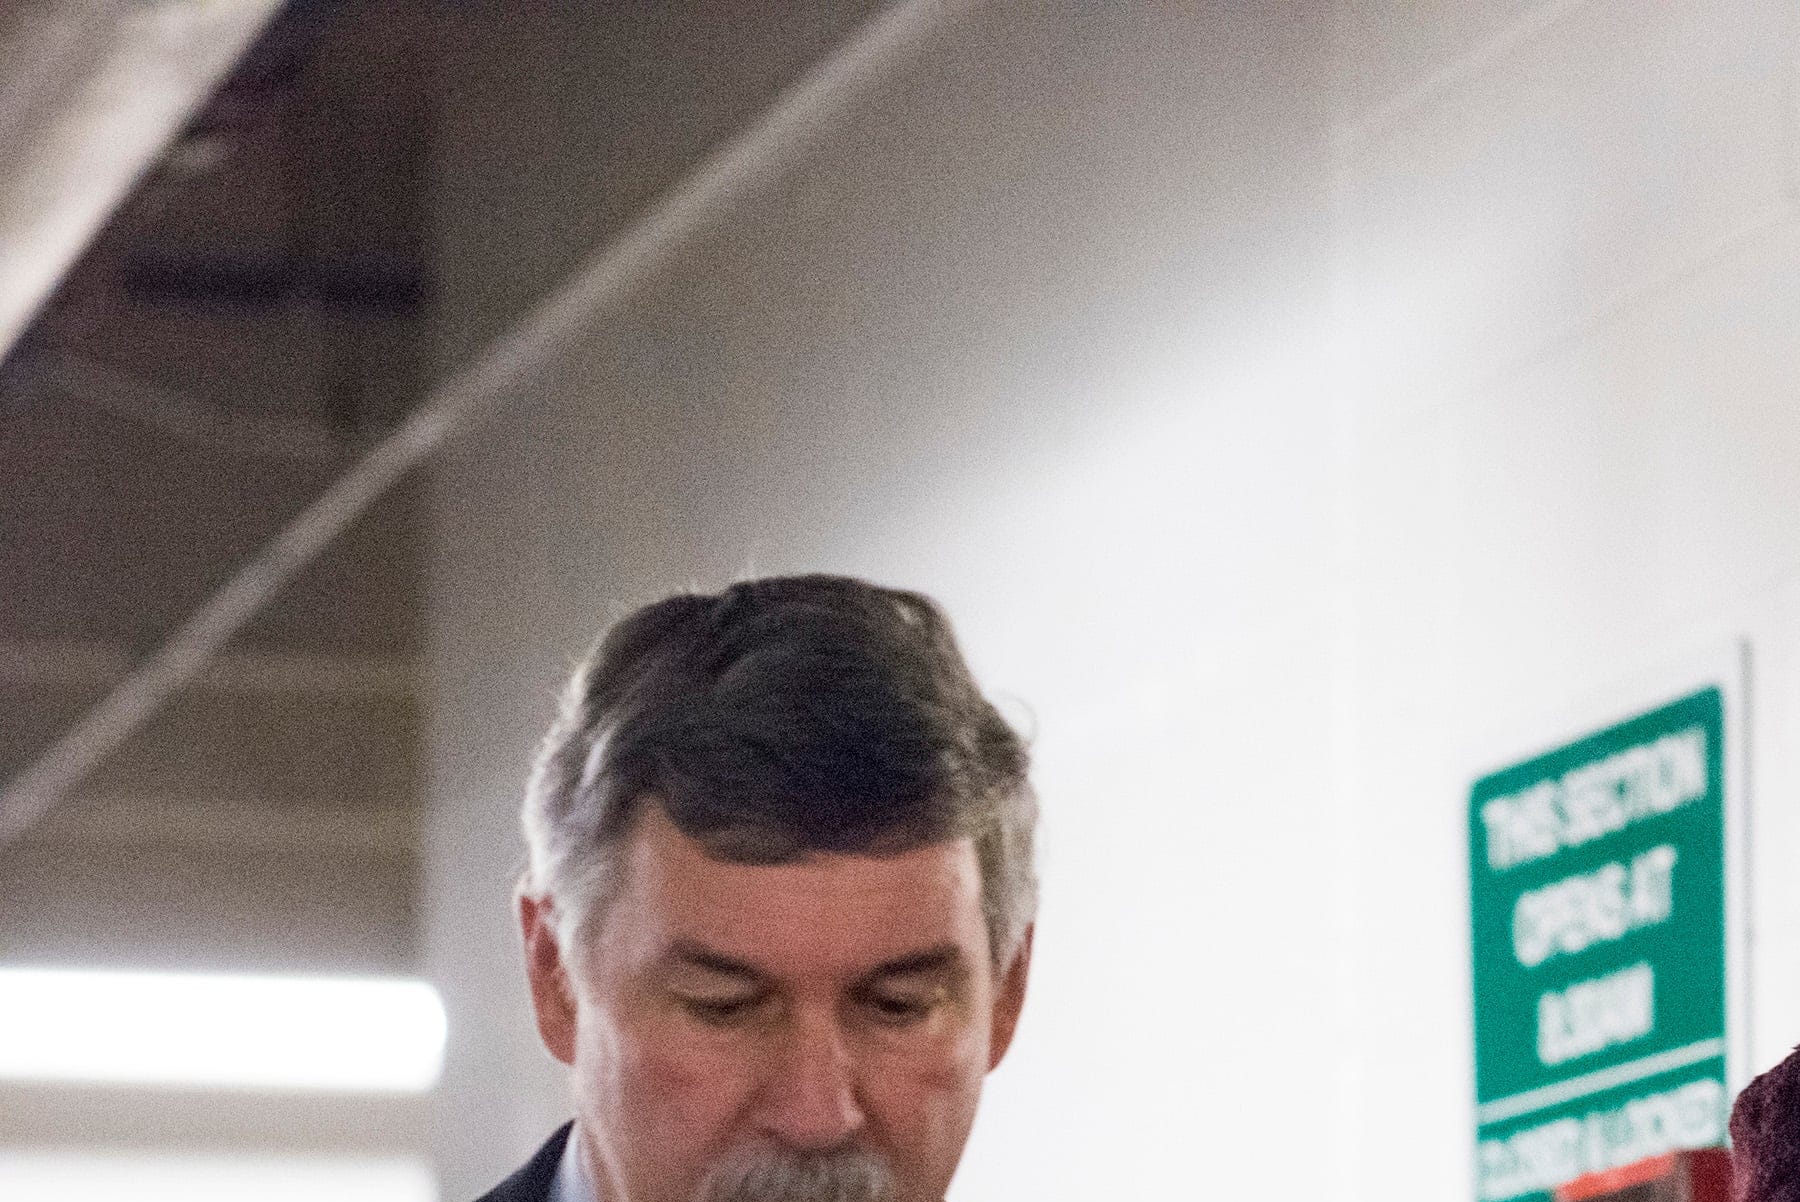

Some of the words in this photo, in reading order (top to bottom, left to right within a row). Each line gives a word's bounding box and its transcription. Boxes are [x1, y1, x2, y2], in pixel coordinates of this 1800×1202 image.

[1482, 779, 1561, 872] THIS
[1559, 724, 1708, 850] SECTION
[1512, 861, 1629, 968] OPENS
[1629, 844, 1678, 928] AT
